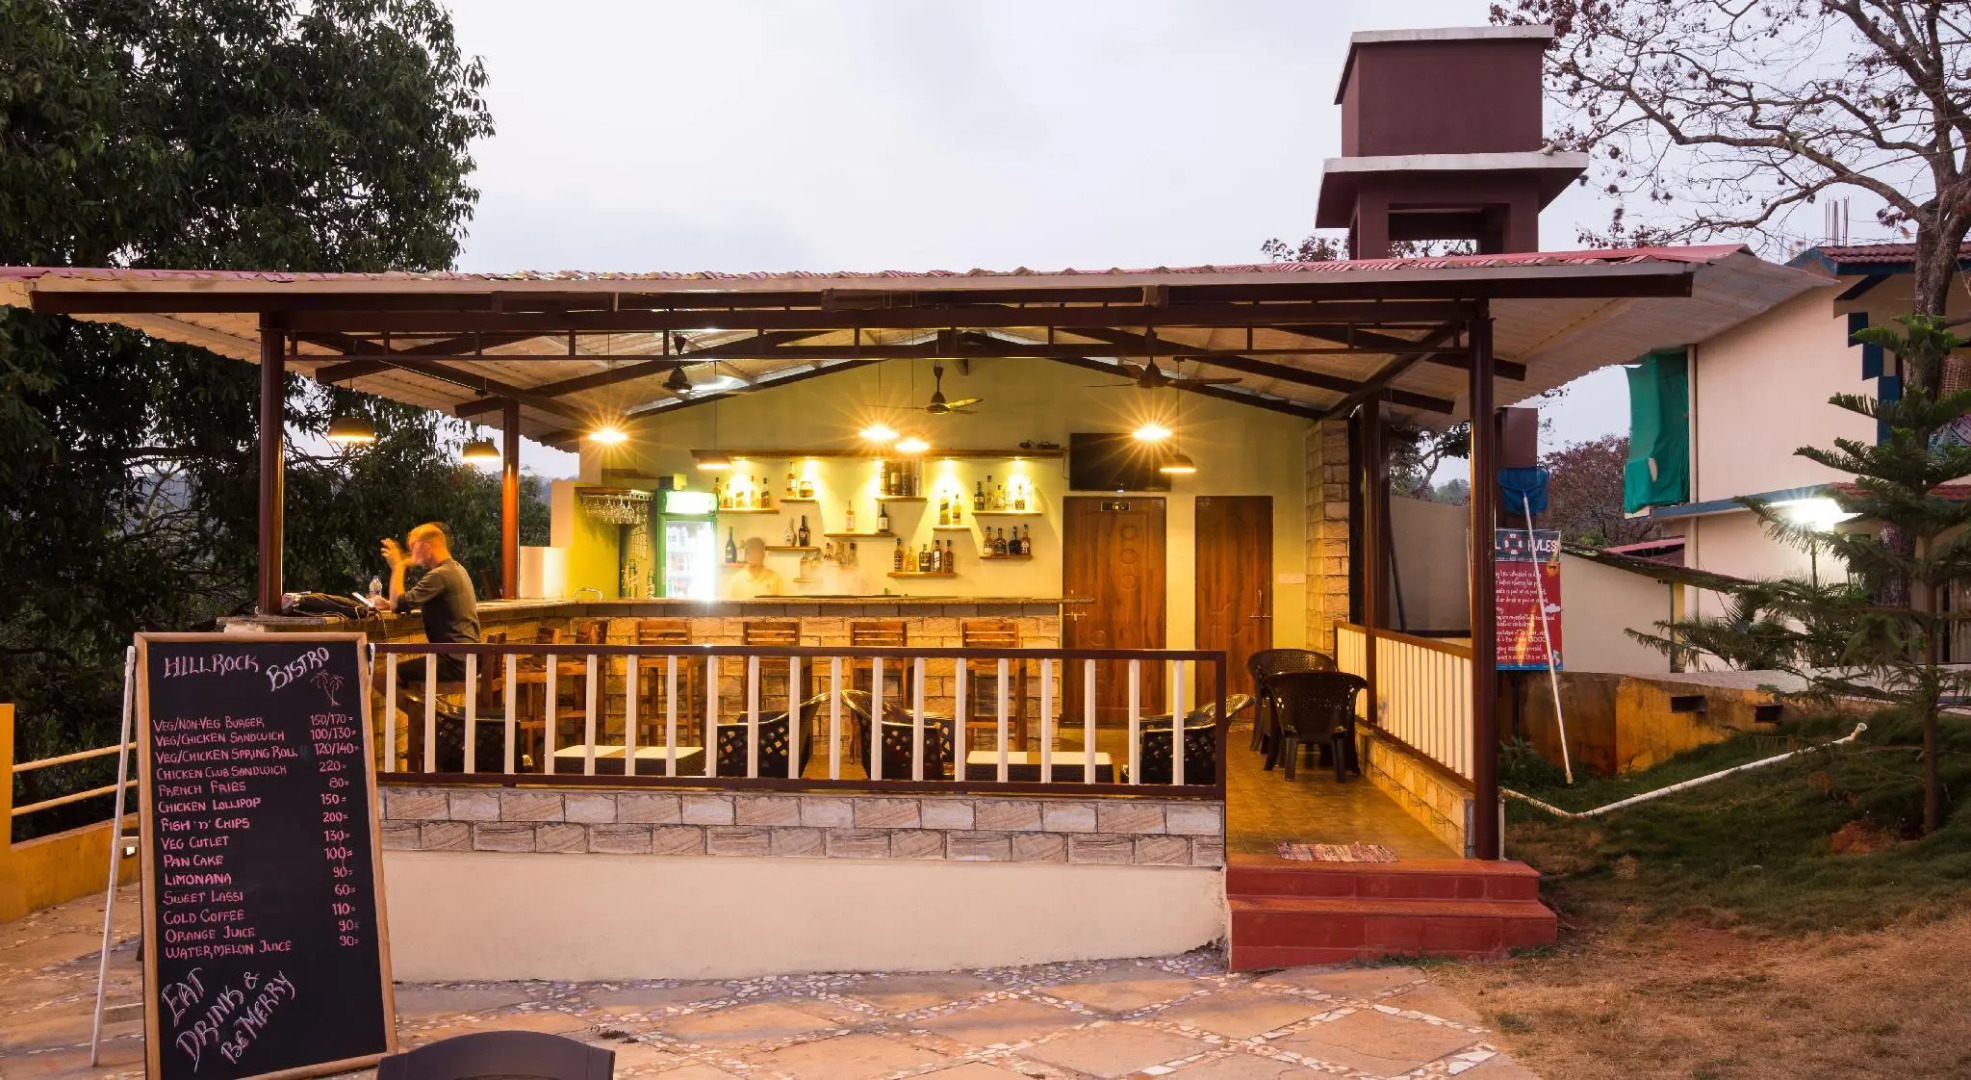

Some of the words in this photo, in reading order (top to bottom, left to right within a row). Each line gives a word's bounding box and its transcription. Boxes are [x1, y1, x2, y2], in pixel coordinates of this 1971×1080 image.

[266, 647, 329, 692] BISTRO
[153, 717, 221, 732] VEG/NON-VEG
[225, 716, 265, 729] BURGER
[155, 733, 226, 747] VEG/CHICKEN
[230, 731, 285, 743] SANDWICH
[155, 749, 229, 764] VEG/CHICKEN
[231, 748, 270, 760] SPRING
[271, 746, 298, 759] ROLL
[156, 767, 203, 781] CHICKEN
[205, 766, 229, 778] CLUB
[231, 765, 287, 777] SANDWICH
[158, 784, 202, 798] FRENCH
[210, 780, 247, 794] FRIES
[158, 801, 206, 813] CHICKEN
[212, 797, 262, 811] LOLLIPOP
[161, 818, 191, 832] FISH
[215, 817, 250, 829] CHIPS
[160, 837, 185, 851] VEG
[189, 835, 229, 848] CUTLET
[163, 854, 190, 868] PAN
[193, 854, 224, 867] CAKE
[164, 873, 232, 886] LIMONANA
[162, 890, 206, 905] SWEET
[211, 890, 244, 903] LASSI
[163, 910, 197, 925] COLD
[200, 908, 245, 922] COFFEE
[165, 928, 216, 943] ORANGE
[223, 925, 255, 939] JUICE
[165, 944, 254, 960] WATERMELON
[259, 940, 292, 953] JUICE
[161, 967, 205, 1028] EAT
[233, 970, 296, 1040] MERRY
[176, 985, 244, 1073] DRINK
[243, 971, 260, 990] &
